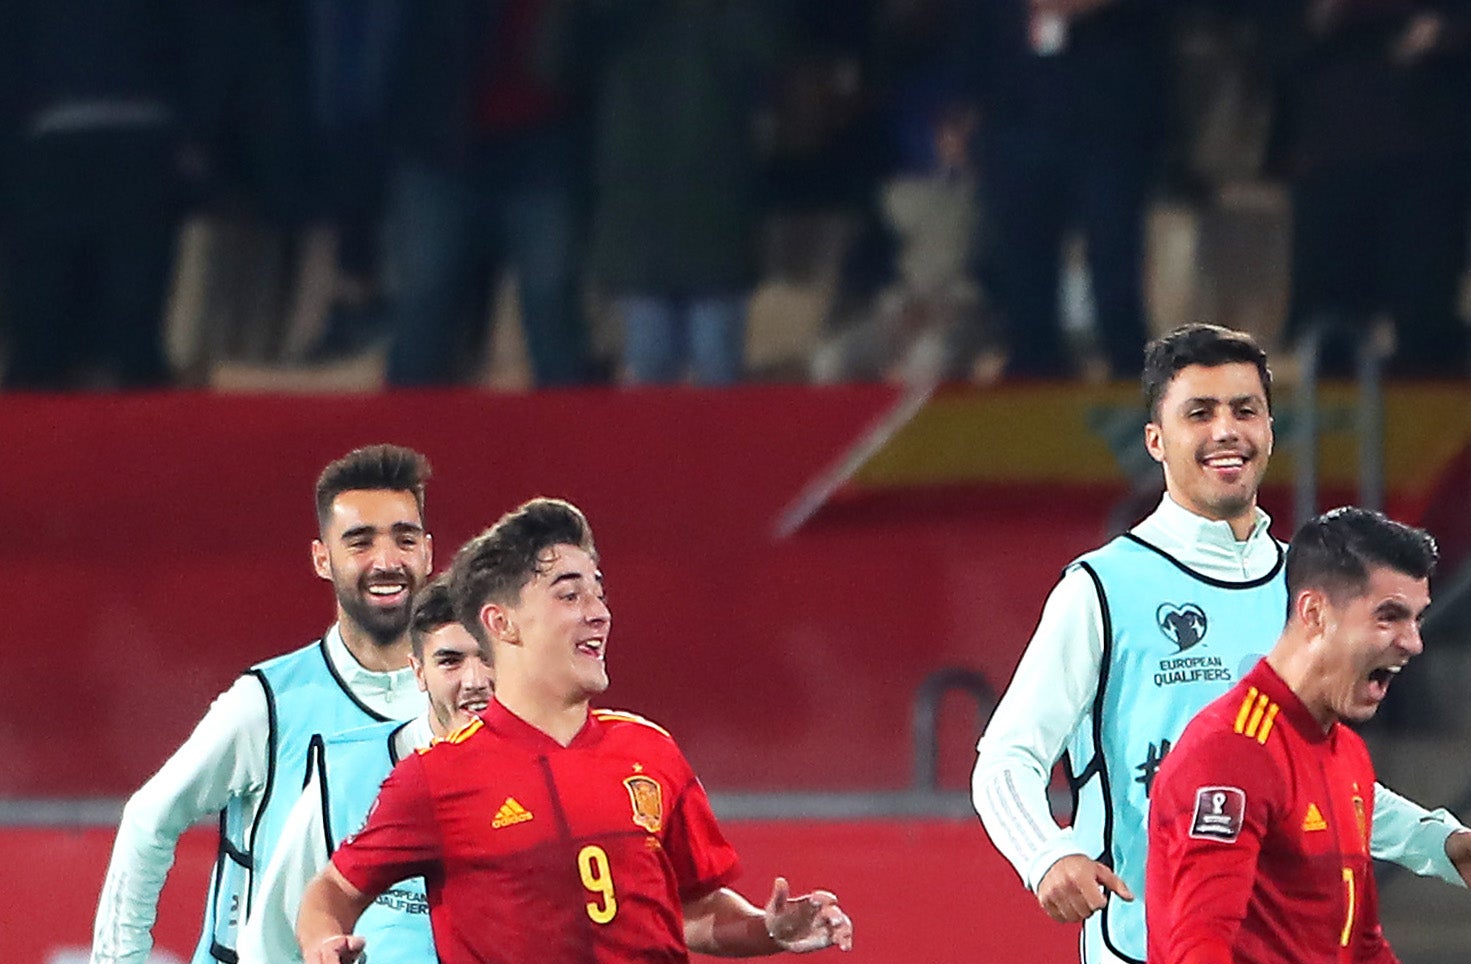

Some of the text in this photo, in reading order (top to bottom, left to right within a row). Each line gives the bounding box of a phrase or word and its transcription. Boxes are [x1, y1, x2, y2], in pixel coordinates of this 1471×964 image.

[1153, 669, 1232, 687] QUALIFIERS
[1160, 656, 1222, 671] EUROPEAN
[578, 845, 617, 924] 9
[1340, 868, 1355, 947] 7
